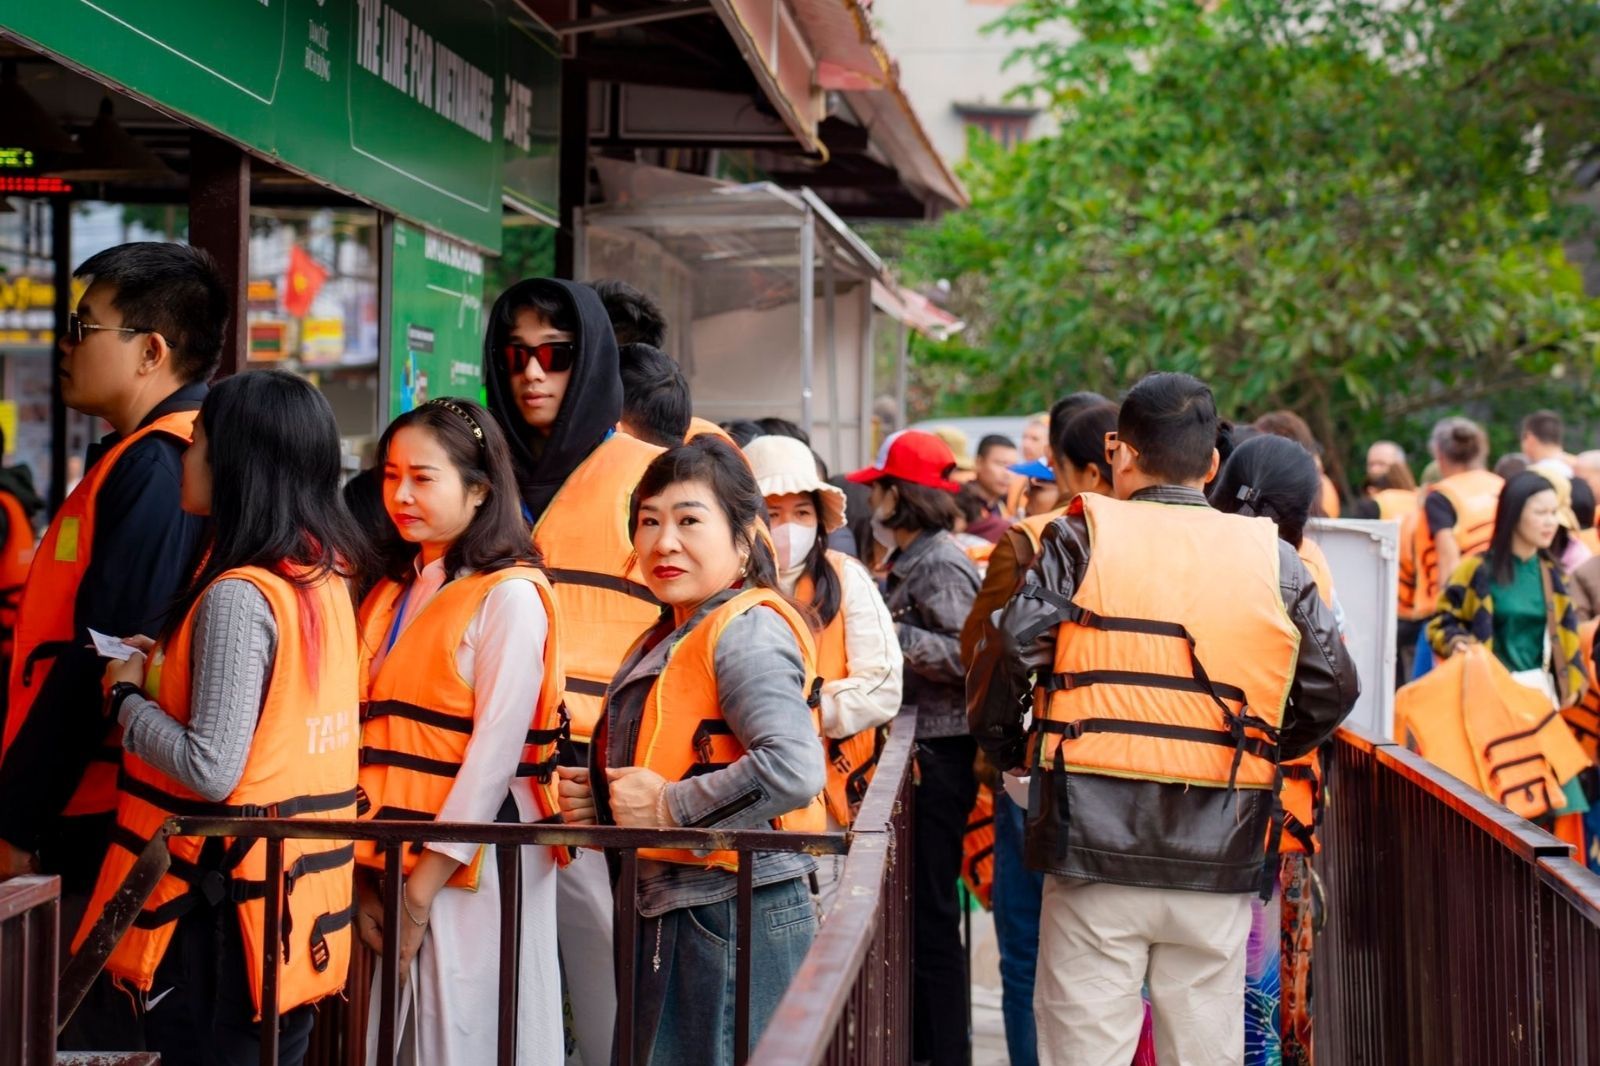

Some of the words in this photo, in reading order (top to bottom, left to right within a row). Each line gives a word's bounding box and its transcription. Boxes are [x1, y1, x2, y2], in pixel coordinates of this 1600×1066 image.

[356, 0, 380, 76] THE
[382, 3, 409, 95] LINE
[409, 23, 434, 110] FOR
[434, 40, 494, 143] VIETNAMESE
